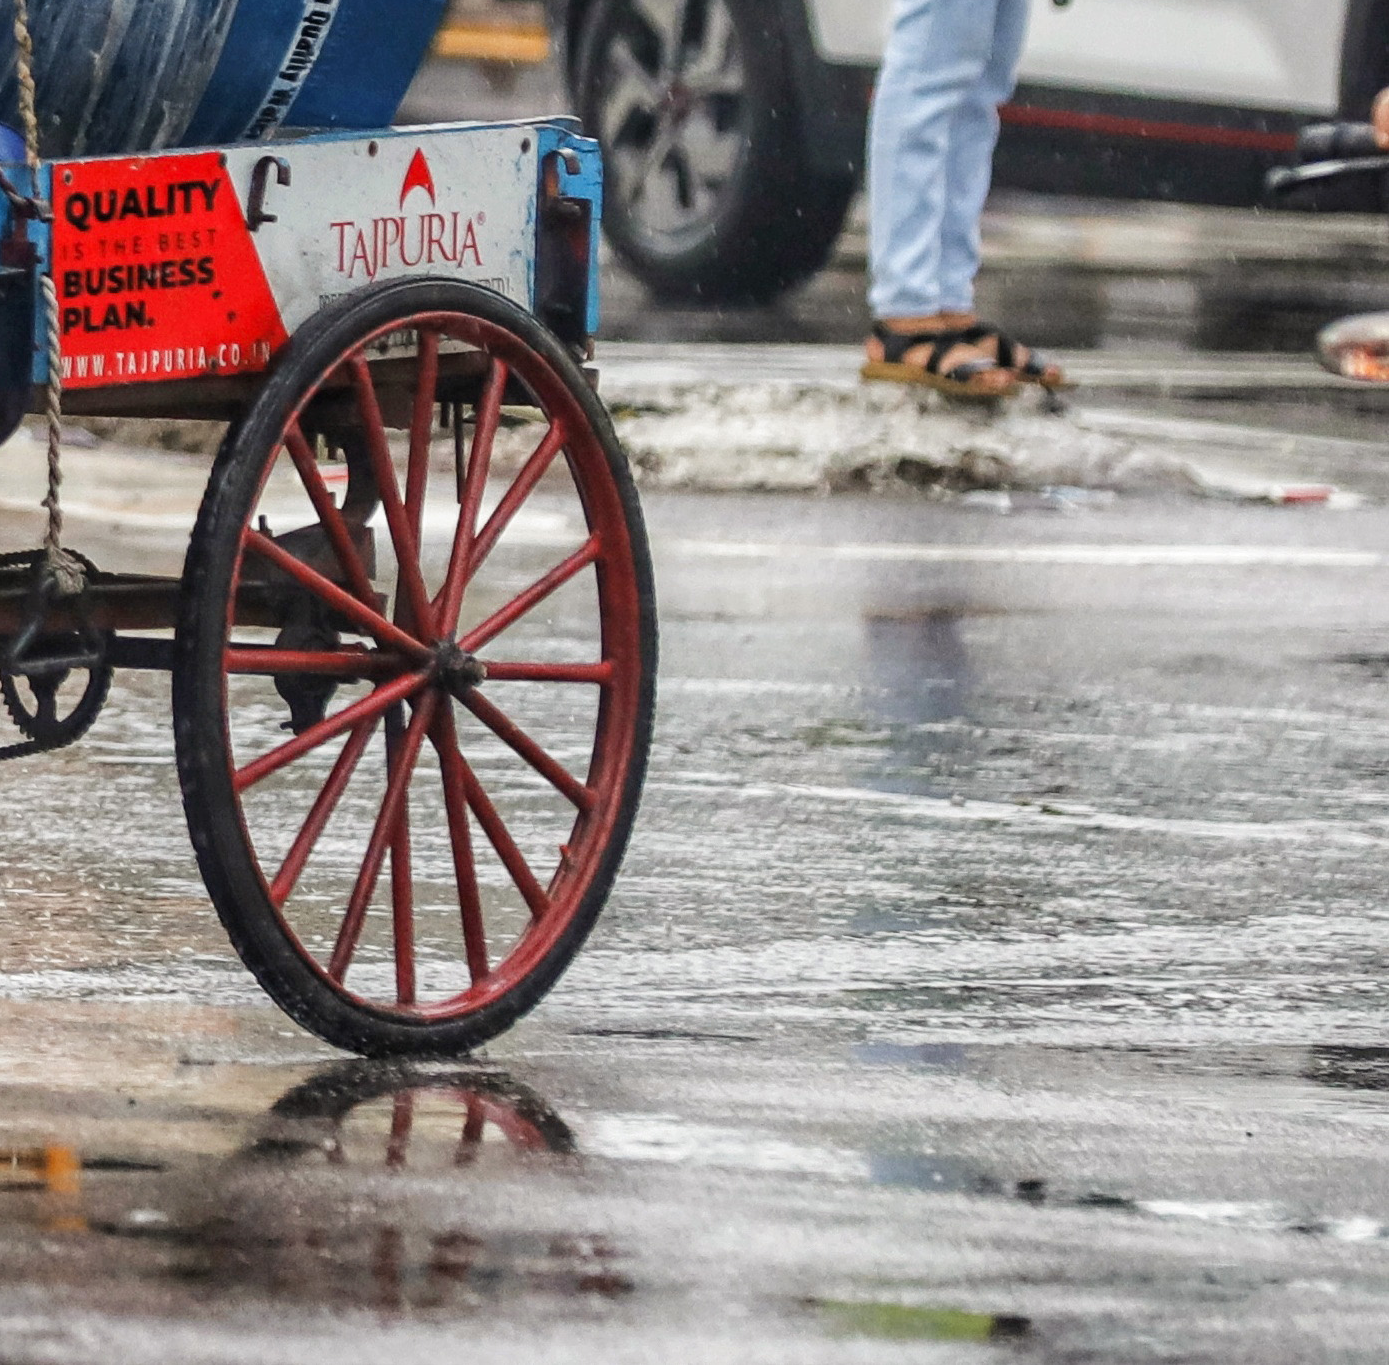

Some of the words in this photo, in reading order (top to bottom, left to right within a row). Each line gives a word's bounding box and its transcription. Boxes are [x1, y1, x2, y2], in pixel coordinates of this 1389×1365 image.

[278, 9, 332, 83] Quality
[64, 178, 221, 232] QUALITY
[61, 239, 84, 262] IS
[99, 235, 143, 258] THE
[158, 228, 217, 252] BEST
[63, 256, 215, 299] BUSINESS
[62, 300, 156, 336] PLAN.
[60, 341, 271, 379] WWW.TAJPURIA.CO.IN
